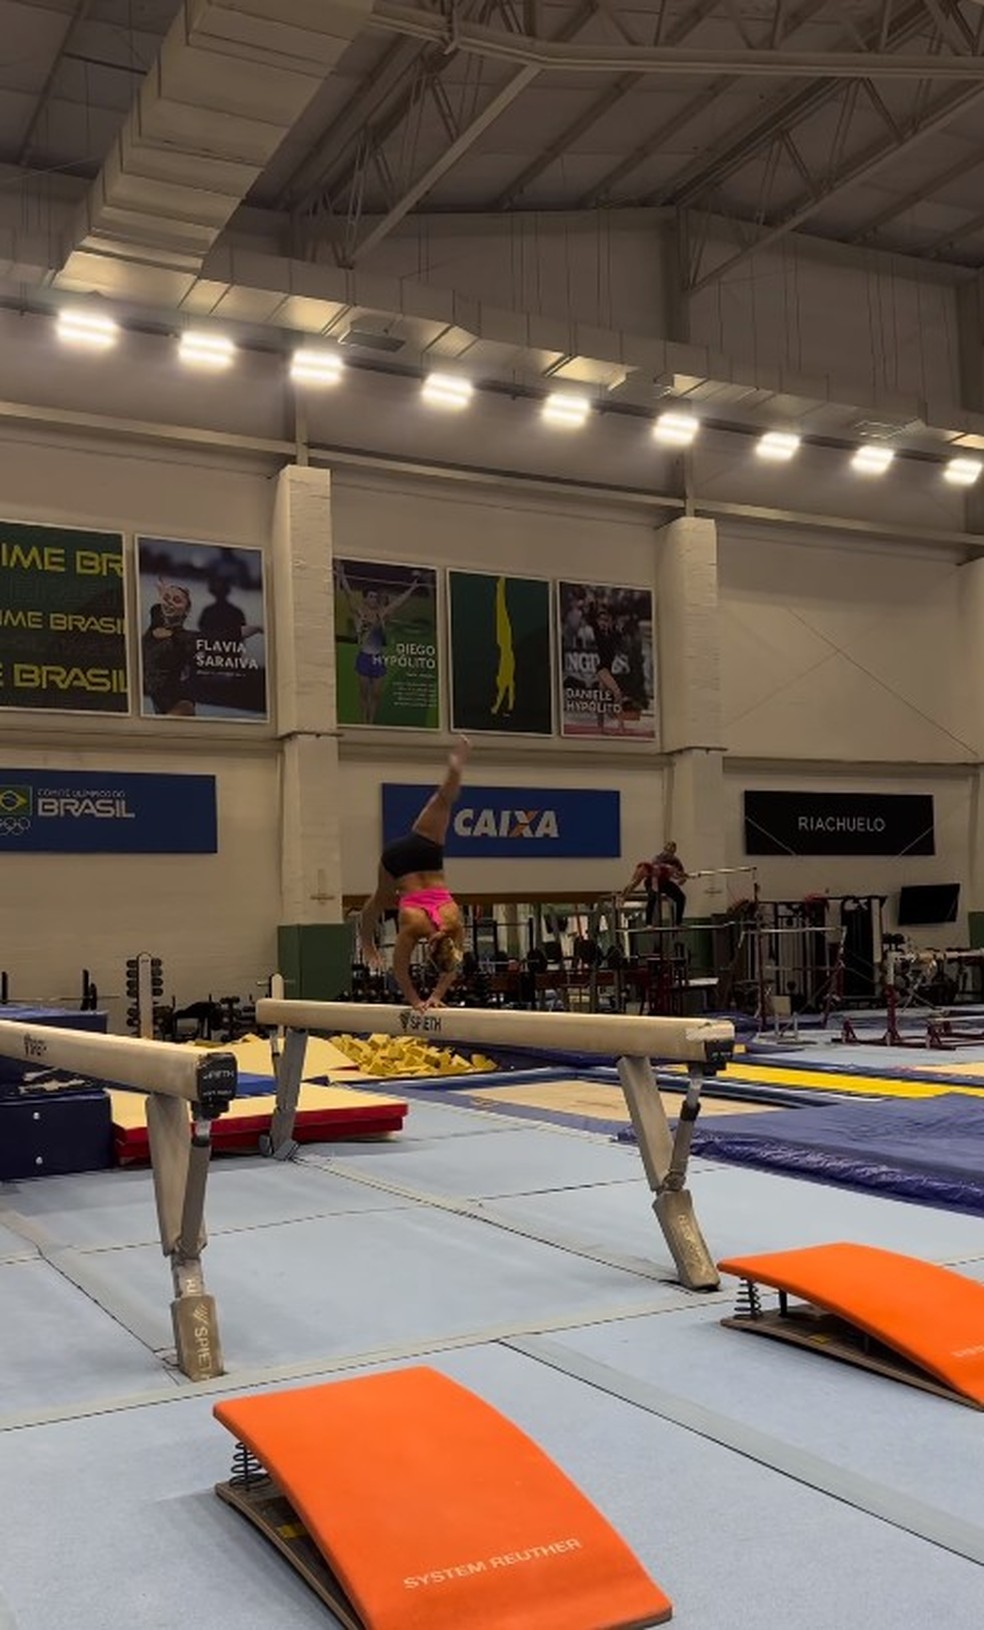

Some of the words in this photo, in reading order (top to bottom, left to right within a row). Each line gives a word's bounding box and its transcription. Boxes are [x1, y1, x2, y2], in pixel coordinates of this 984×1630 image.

[1, 543, 65, 572] IME
[196, 639, 247, 653] FLAVIA
[396, 643, 436, 656] DIEGO
[196, 655, 259, 670] SARAIVA
[372, 654, 436, 669] HYPÓLITO
[566, 687, 613, 702] DANIELE
[37, 798, 136, 818] BRASIL
[453, 808, 559, 838] CAIXA
[798, 816, 886, 832] RIACHUELO
[410, 1015, 442, 1032] SPIETH
[403, 1561, 487, 1589] SYSTEM
[489, 1537, 583, 1569] REUTHER
